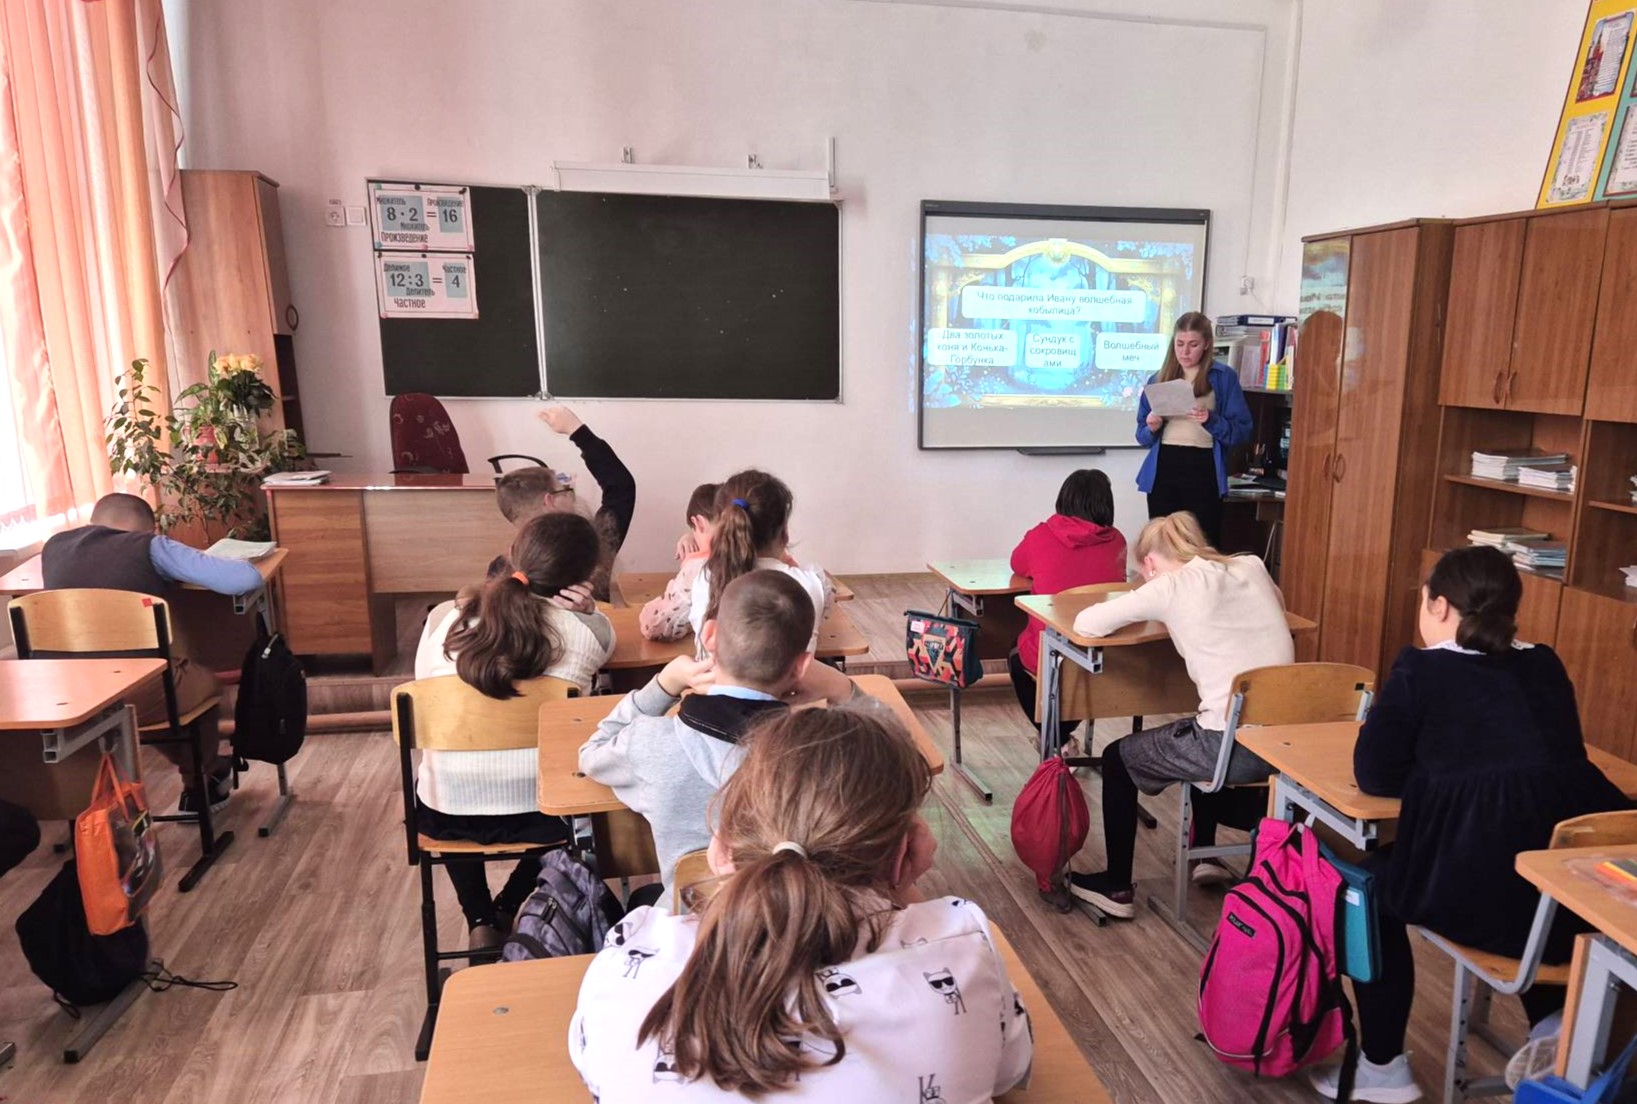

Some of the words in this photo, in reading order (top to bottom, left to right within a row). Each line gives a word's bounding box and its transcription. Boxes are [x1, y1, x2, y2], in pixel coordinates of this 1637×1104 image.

[442, 208, 458, 223] 16
[451, 275, 460, 288] 4
[977, 291, 995, 301] Что
[997, 293, 1044, 303] подарила
[1047, 293, 1076, 305] Ивану
[1079, 294, 1133, 305] волшебная
[1028, 306, 1081, 317] кобылица?
[942, 329, 961, 340] Два
[964, 331, 1004, 340] золотых
[1032, 333, 1066, 345] Сундук
[937, 343, 960, 351] коня
[1103, 340, 1160, 350] Волшебный
[1029, 346, 1077, 357] сокровищ
[950, 355, 994, 366] Горбунка
[1043, 359, 1062, 367] ами
